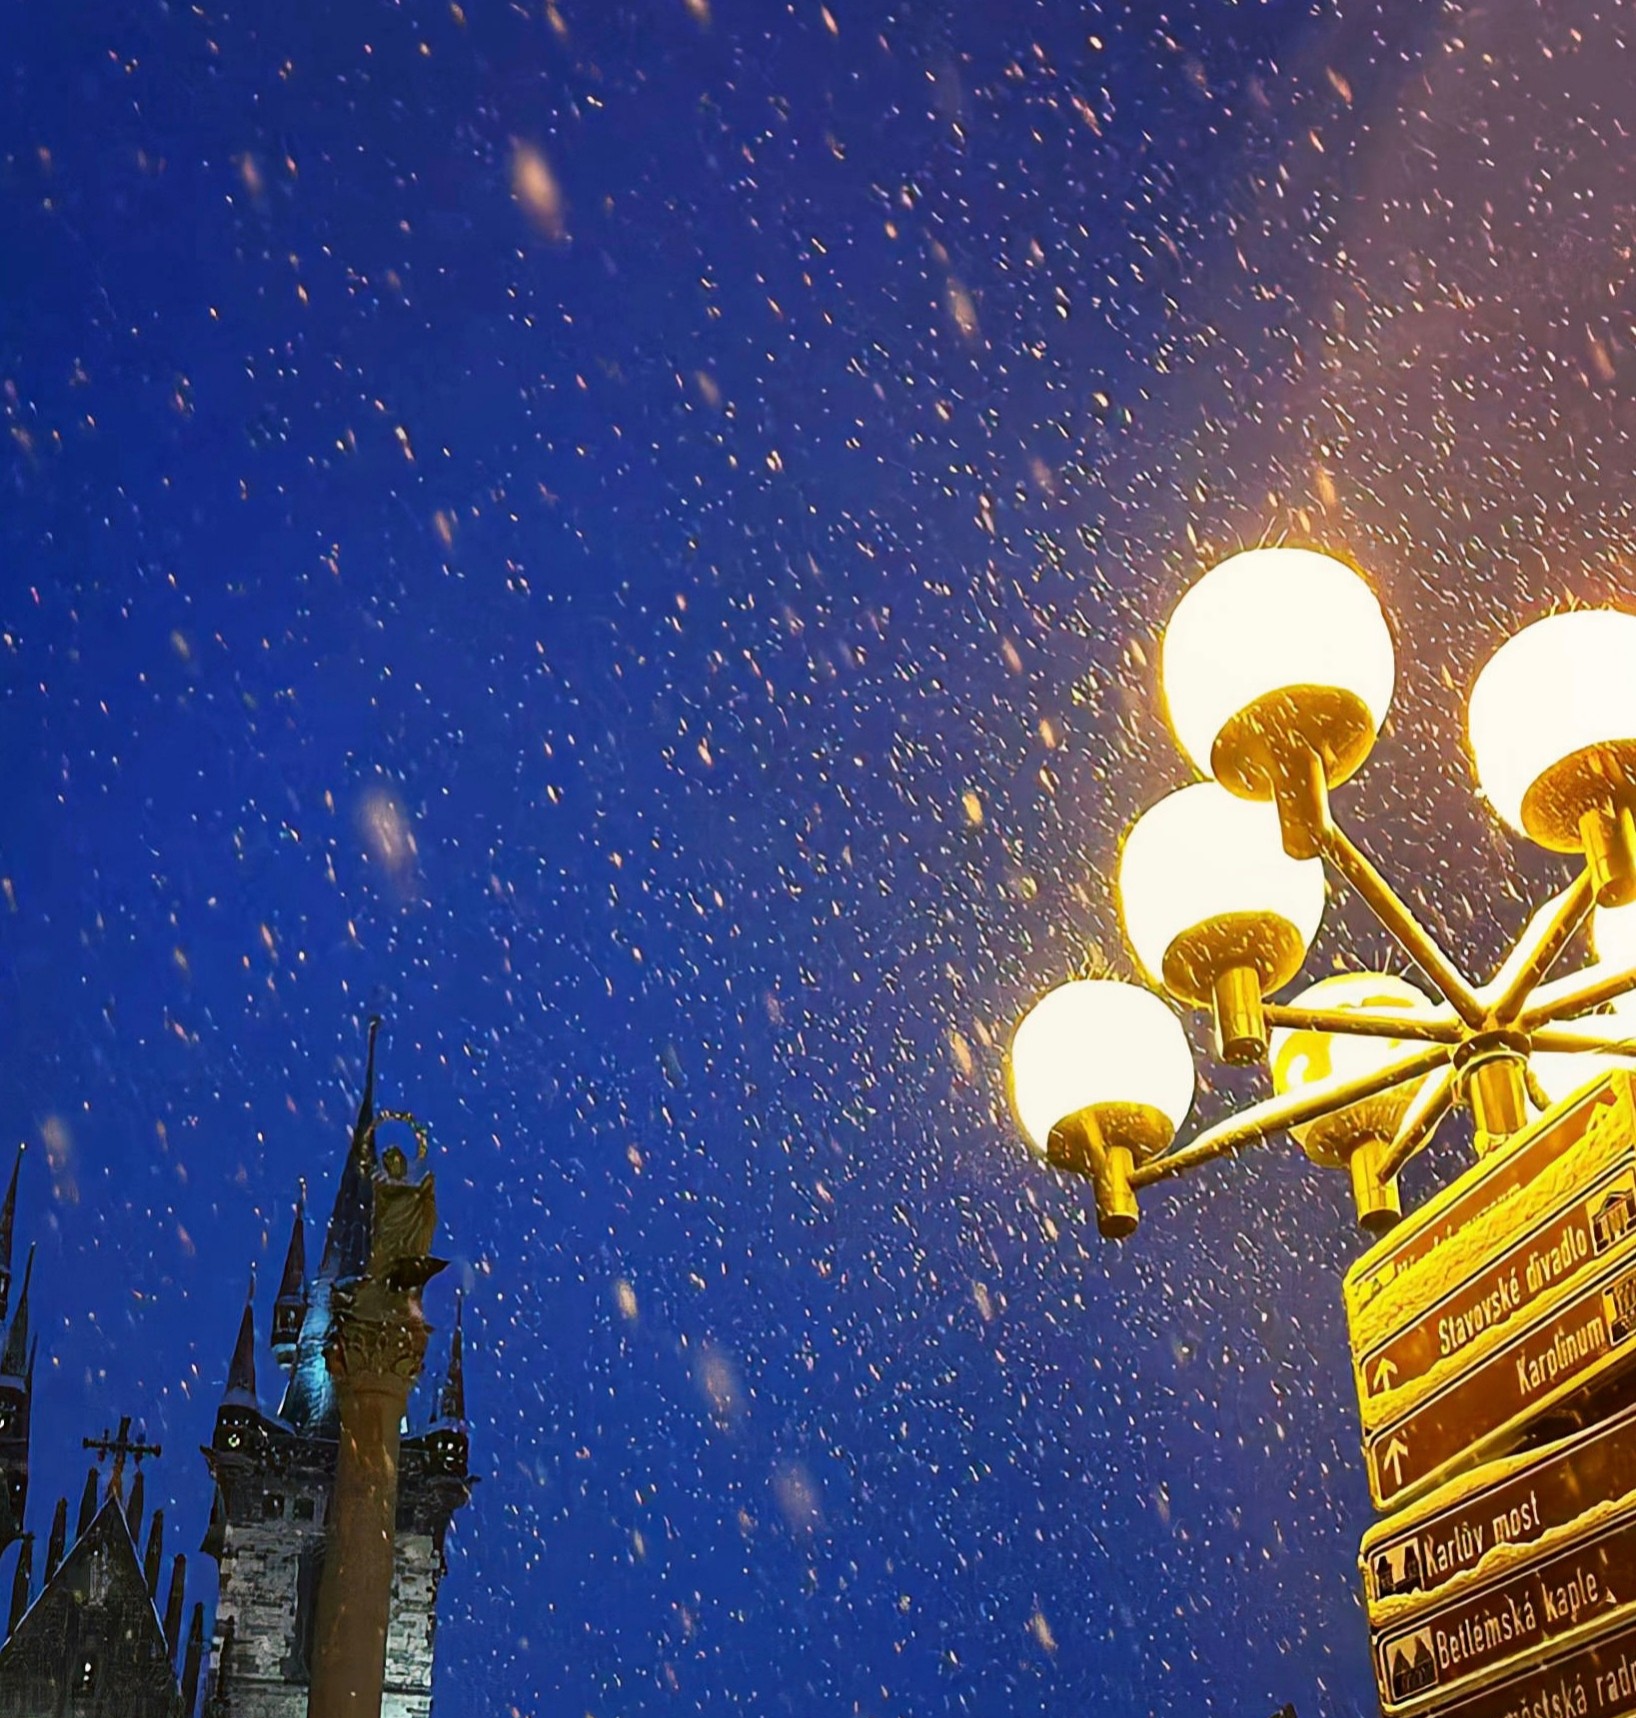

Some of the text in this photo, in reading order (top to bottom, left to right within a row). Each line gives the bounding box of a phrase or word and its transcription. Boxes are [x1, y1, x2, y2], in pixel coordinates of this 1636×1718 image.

[1438, 1266, 1521, 1356] Stavovské
[1526, 1225, 1588, 1293] divadlo
[1516, 1317, 1605, 1396] Karolinum
[1424, 1490, 1541, 1578] Karlův most
[1435, 1567, 1599, 1670] Betlémská kaple
